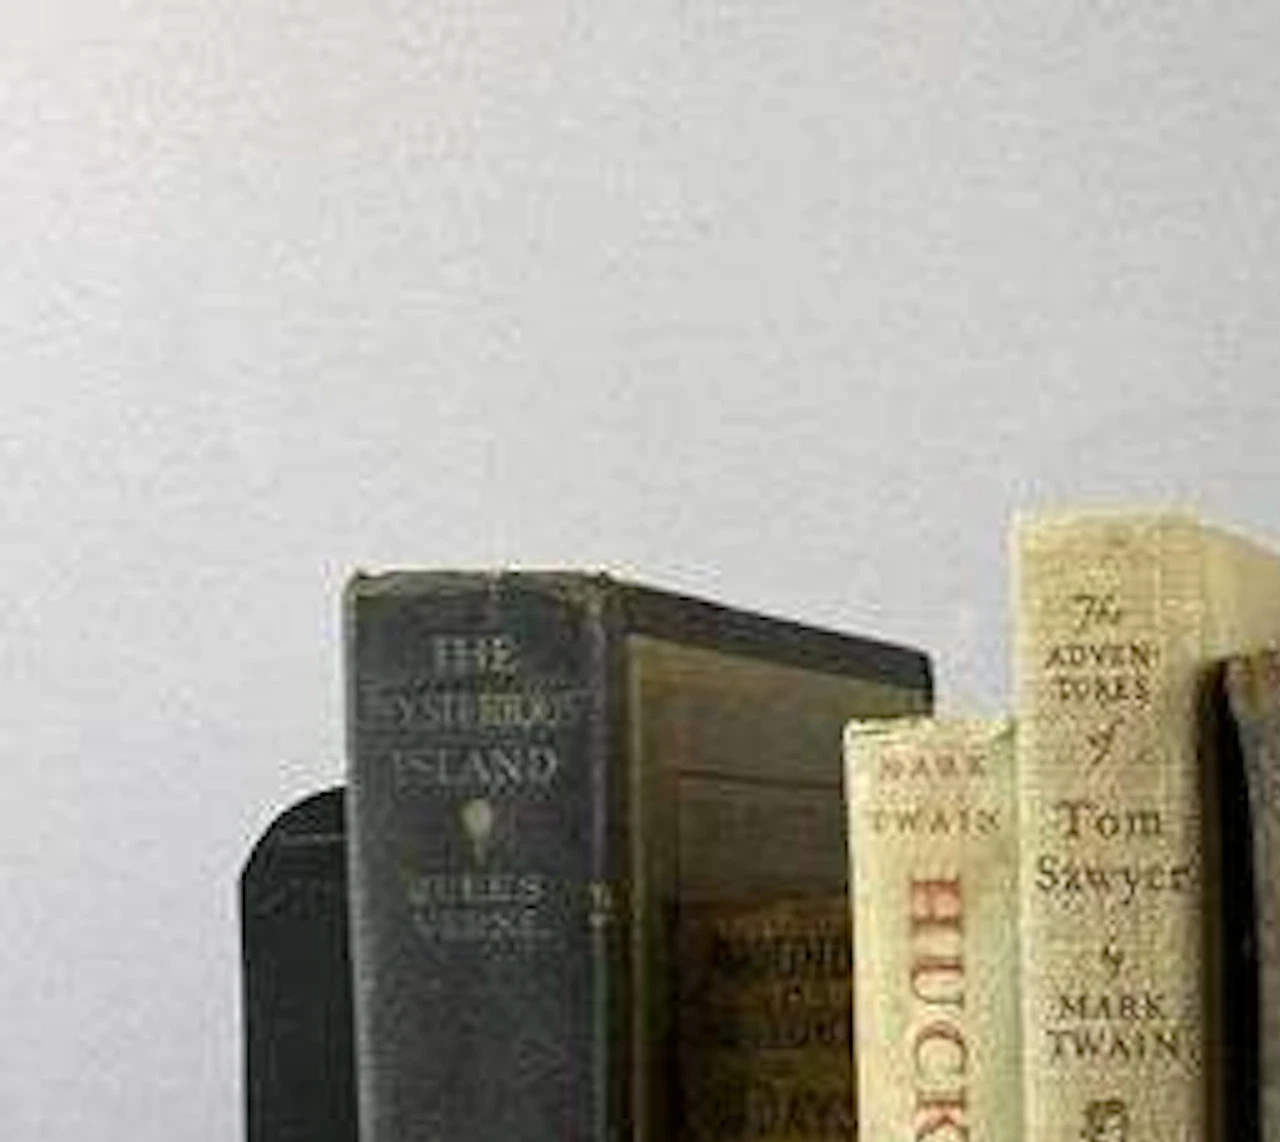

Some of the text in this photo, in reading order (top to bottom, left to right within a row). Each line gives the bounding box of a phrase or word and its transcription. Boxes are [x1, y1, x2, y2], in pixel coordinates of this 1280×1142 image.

[1073, 595, 1122, 631] The
[391, 748, 558, 790] ISLAND
[871, 806, 1001, 835] TWAIN
[1058, 800, 1162, 839] Tom
[1035, 853, 1192, 904] Sawyer
[1058, 994, 1166, 1021] MARK
[1046, 1029, 1182, 1063] TWAIN
